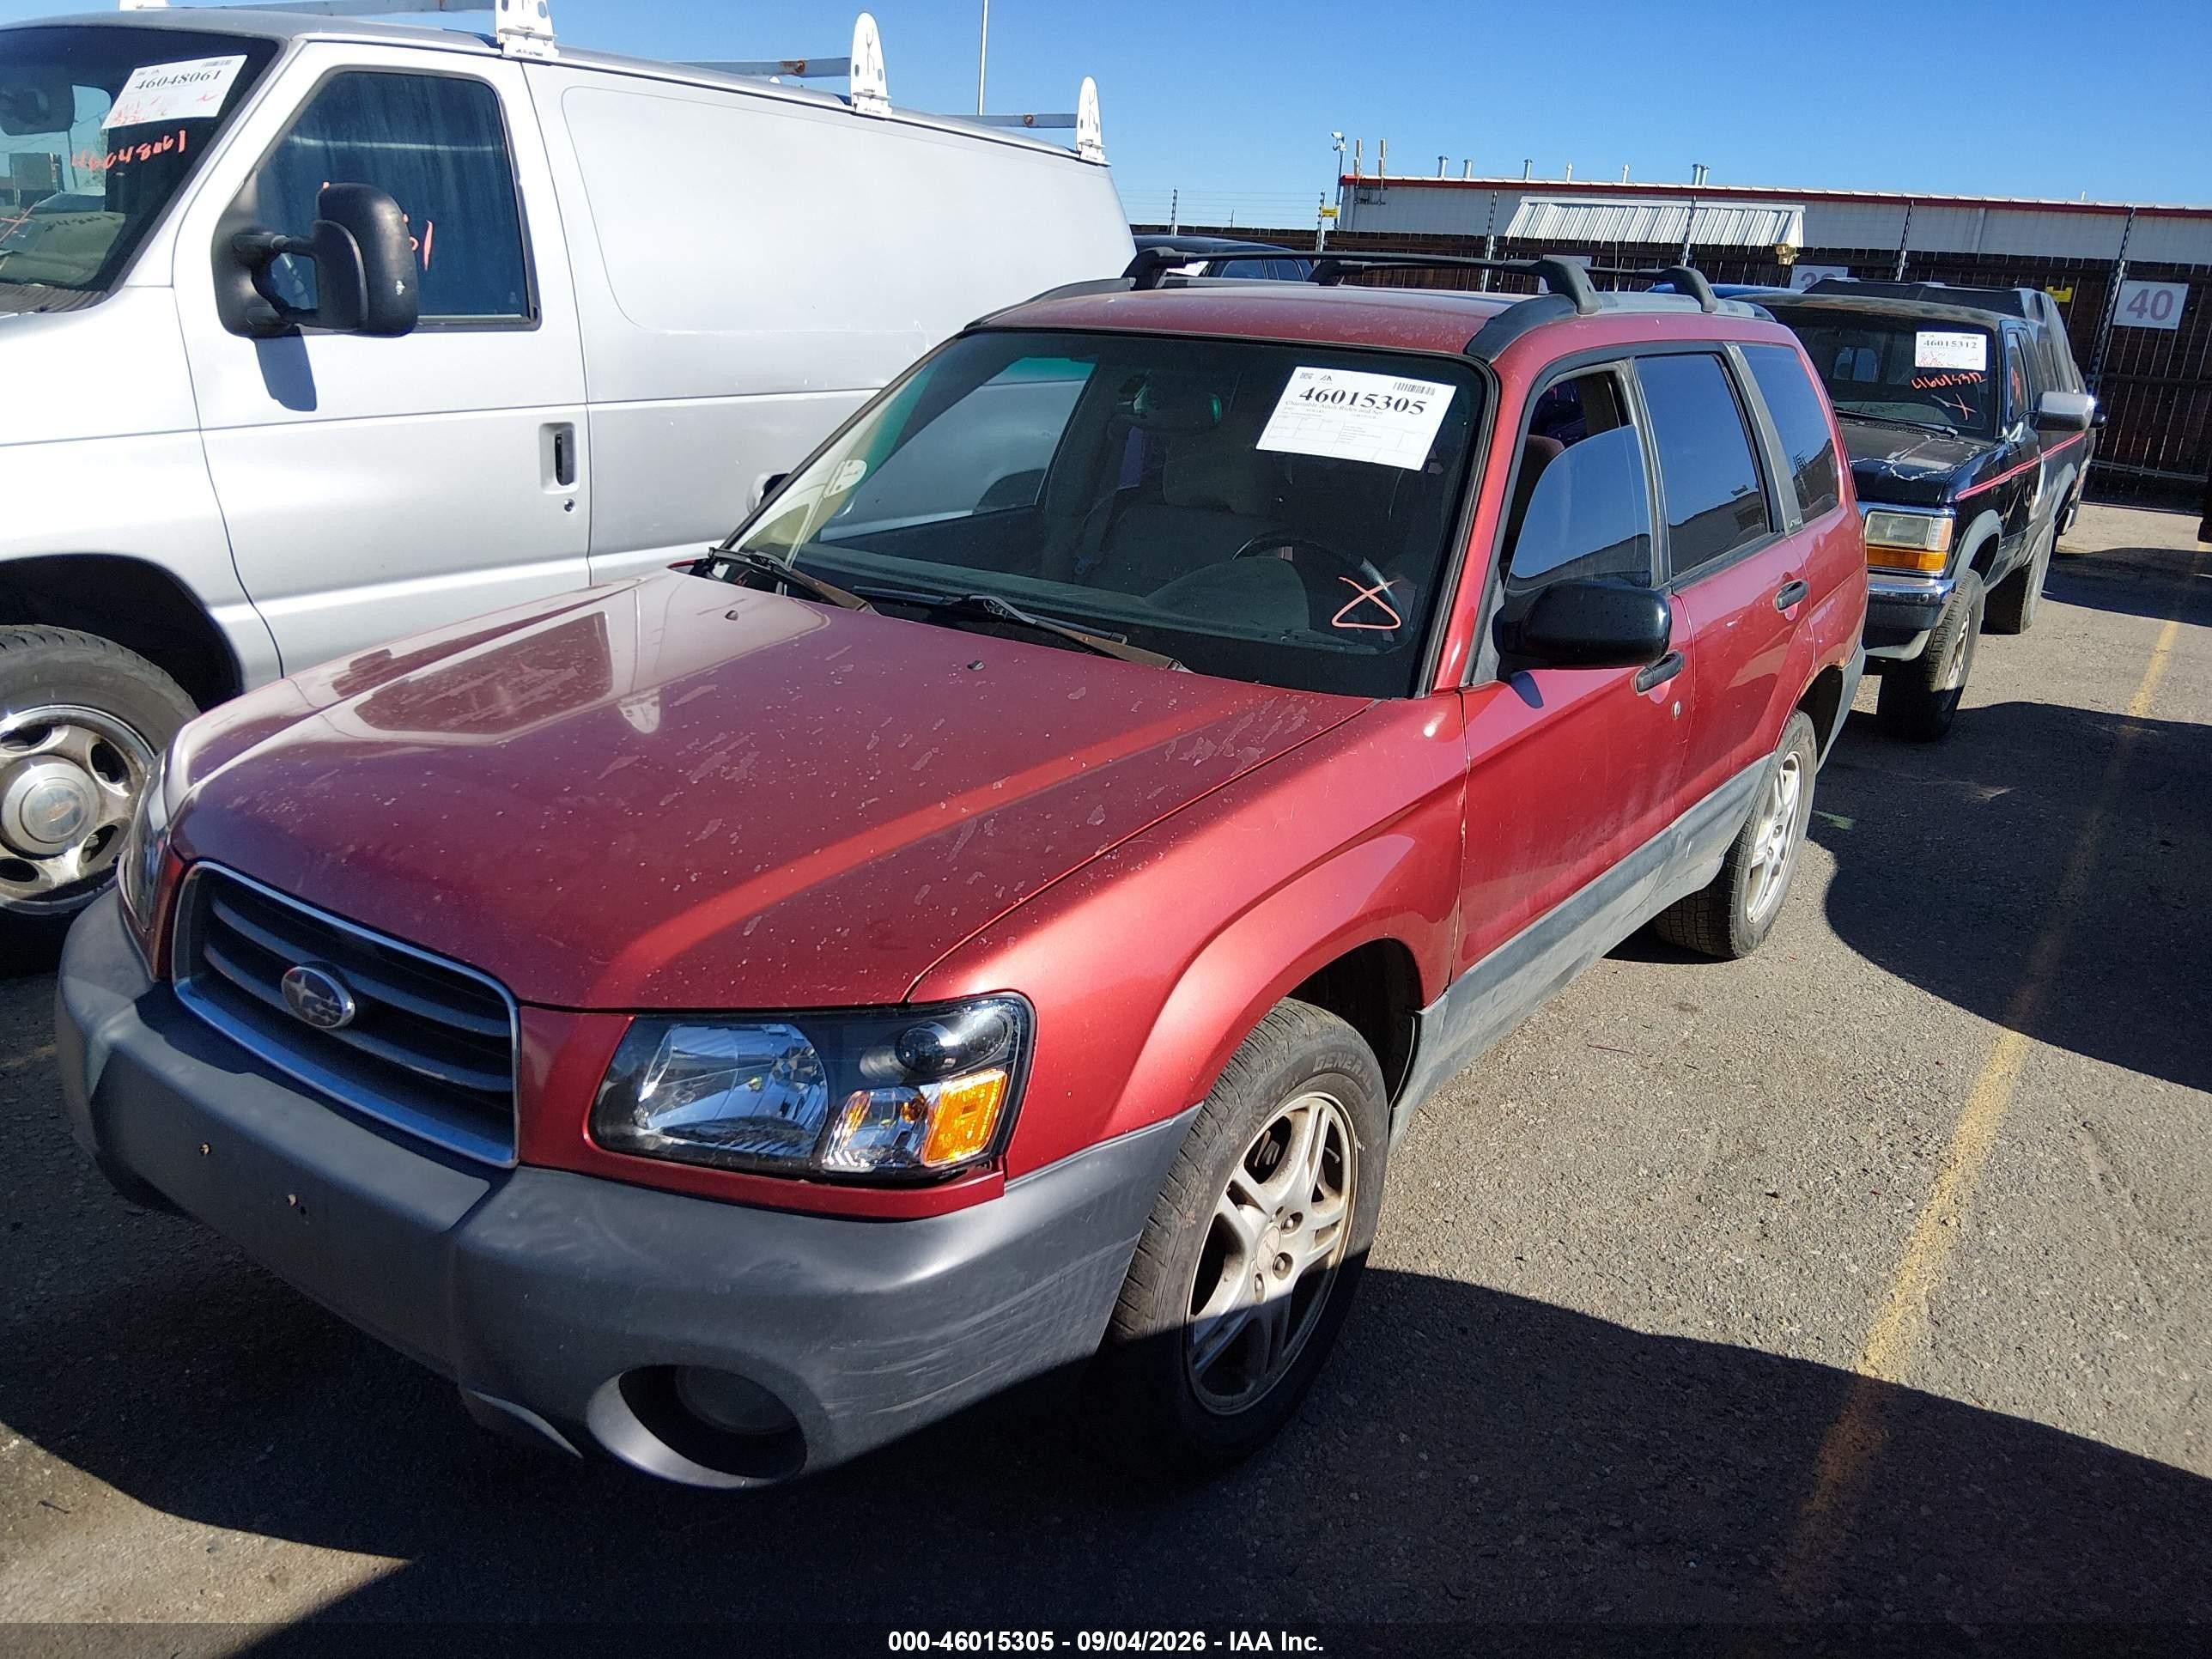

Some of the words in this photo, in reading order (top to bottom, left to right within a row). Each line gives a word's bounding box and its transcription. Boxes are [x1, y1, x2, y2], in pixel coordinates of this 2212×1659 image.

[135, 70, 222, 91] 46048061
[2126, 289, 2173, 321] 40
[1923, 339, 1978, 349] 46015312
[1299, 386, 1428, 416] 46015305
[1312, 1052, 1373, 1092] GENERAL
